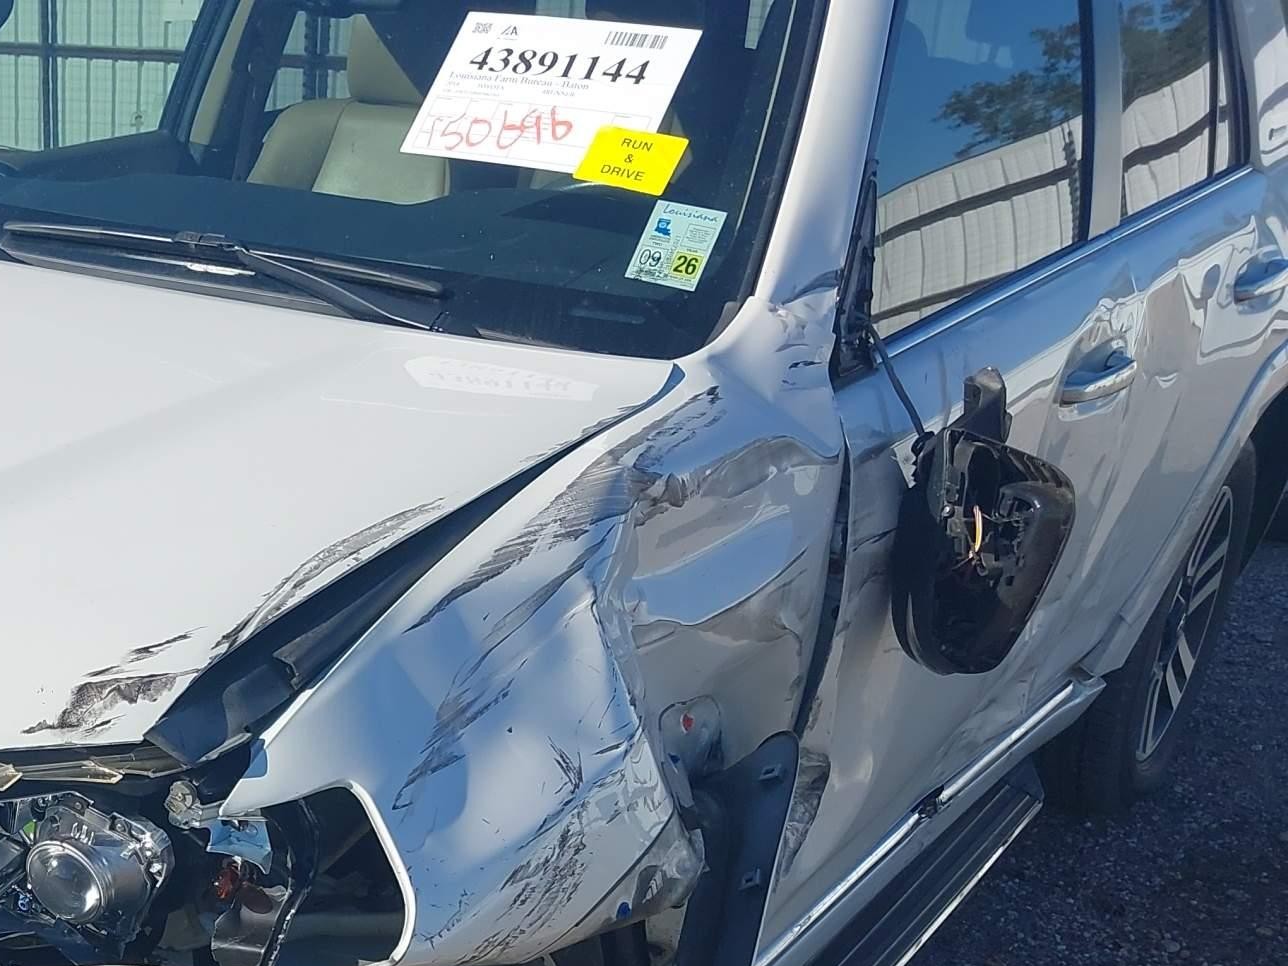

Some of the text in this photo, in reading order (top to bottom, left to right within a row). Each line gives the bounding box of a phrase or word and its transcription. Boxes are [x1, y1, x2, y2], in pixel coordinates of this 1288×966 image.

[469, 46, 650, 85] 43891144
[448, 71, 493, 82] Louisiana
[620, 137, 654, 152] RUN
[624, 153, 634, 163] &
[600, 164, 646, 182] DRIVE
[662, 203, 719, 223] Louisiana
[638, 248, 662, 268] 09
[672, 255, 699, 275] 26
